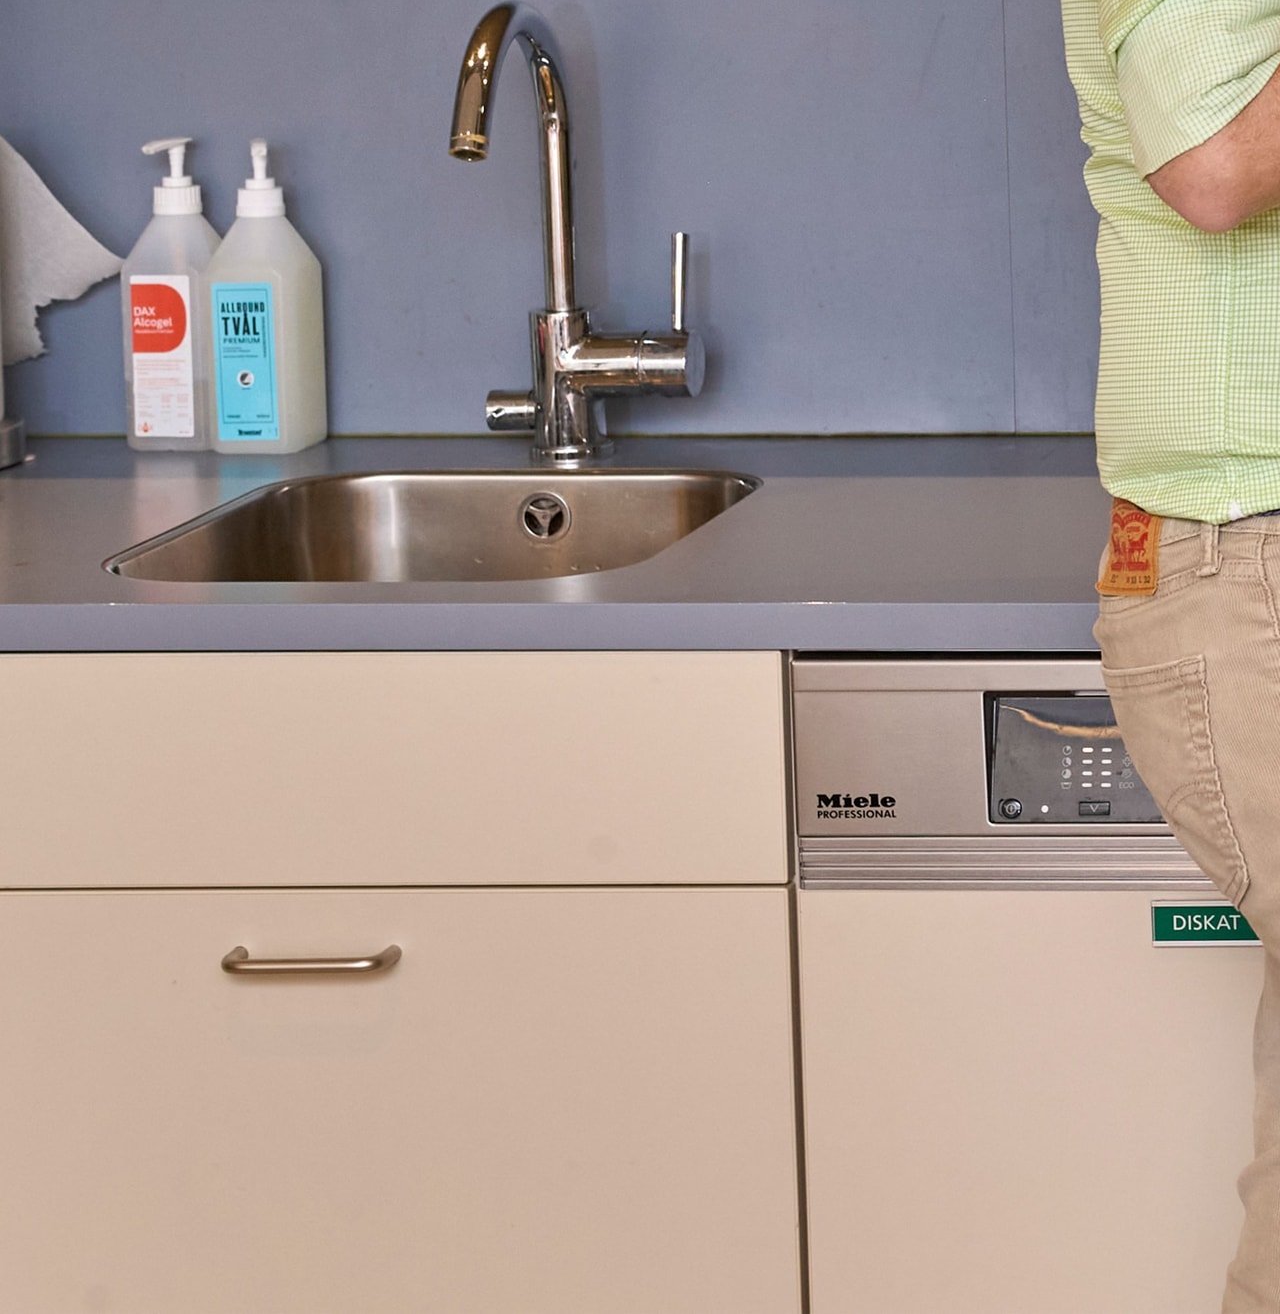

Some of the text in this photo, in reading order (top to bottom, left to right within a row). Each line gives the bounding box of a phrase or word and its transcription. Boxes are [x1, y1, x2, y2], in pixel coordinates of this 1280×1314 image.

[133, 306, 156, 316] DAX
[221, 301, 265, 313] ALLROUND
[133, 317, 173, 330] Alcogel
[1119, 781, 1134, 789] ECO
[816, 793, 896, 808] Miele
[817, 809, 897, 819] PROFESSIONAL
[1173, 914, 1241, 931] DISKAT
